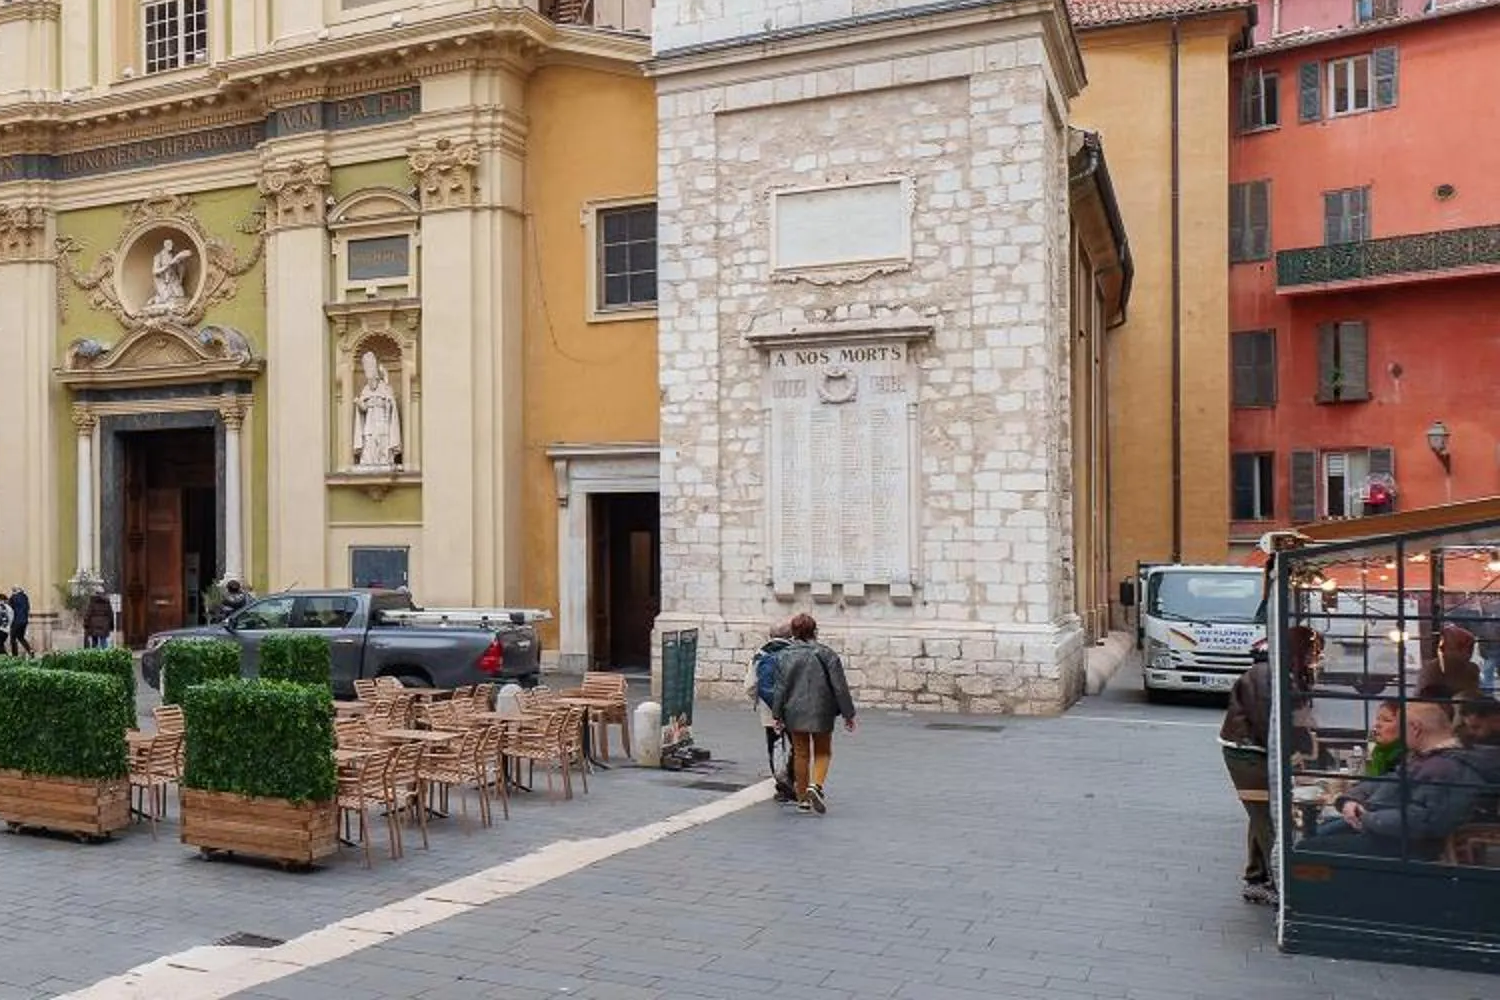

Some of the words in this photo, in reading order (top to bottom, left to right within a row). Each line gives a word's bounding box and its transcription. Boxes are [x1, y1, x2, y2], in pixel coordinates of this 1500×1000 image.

[775, 353, 786, 367] A
[795, 351, 829, 365] NOS
[840, 347, 901, 362] MORTS
